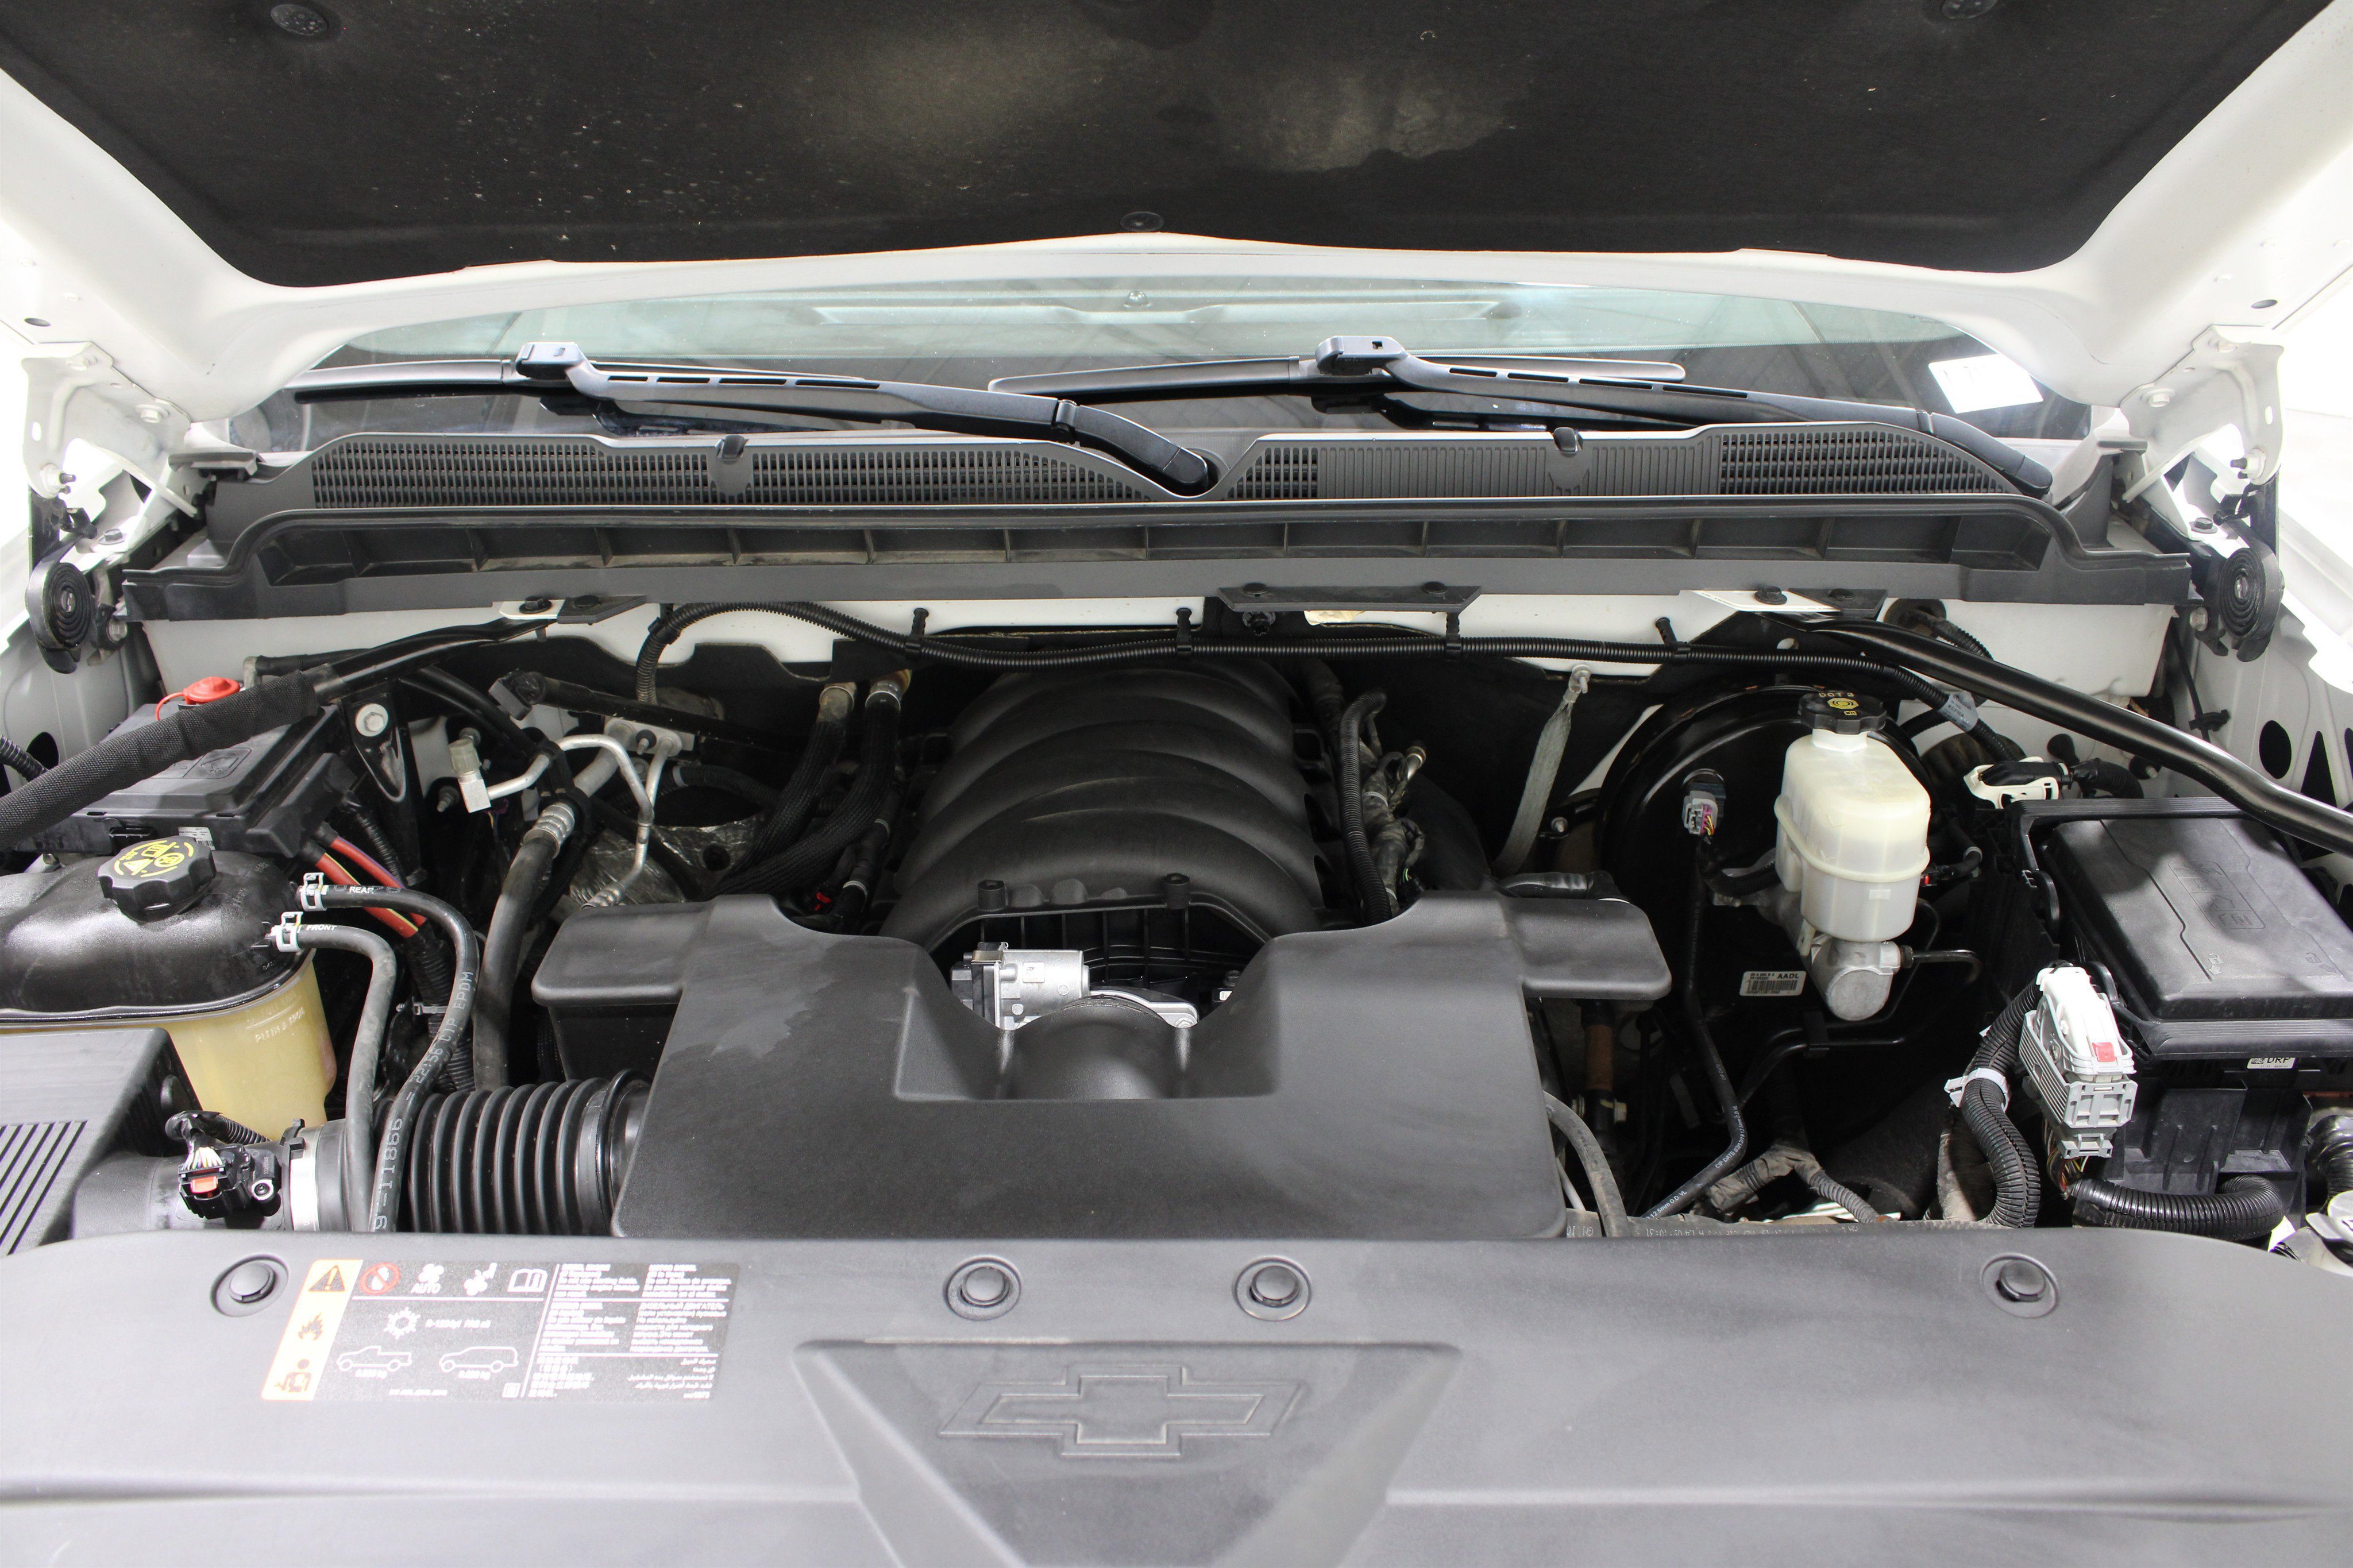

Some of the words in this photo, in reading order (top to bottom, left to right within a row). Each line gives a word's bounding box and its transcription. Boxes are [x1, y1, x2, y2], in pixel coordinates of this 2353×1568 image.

[349, 886, 375, 894] REAR
[453, 971, 474, 1010] EPDM
[1715, 1160, 1723, 1168] CIP
[1723, 1152, 1735, 1163] DATE
[1650, 1202, 1671, 1216] 12.5mm
[411, 1283, 441, 1294] AUTO
